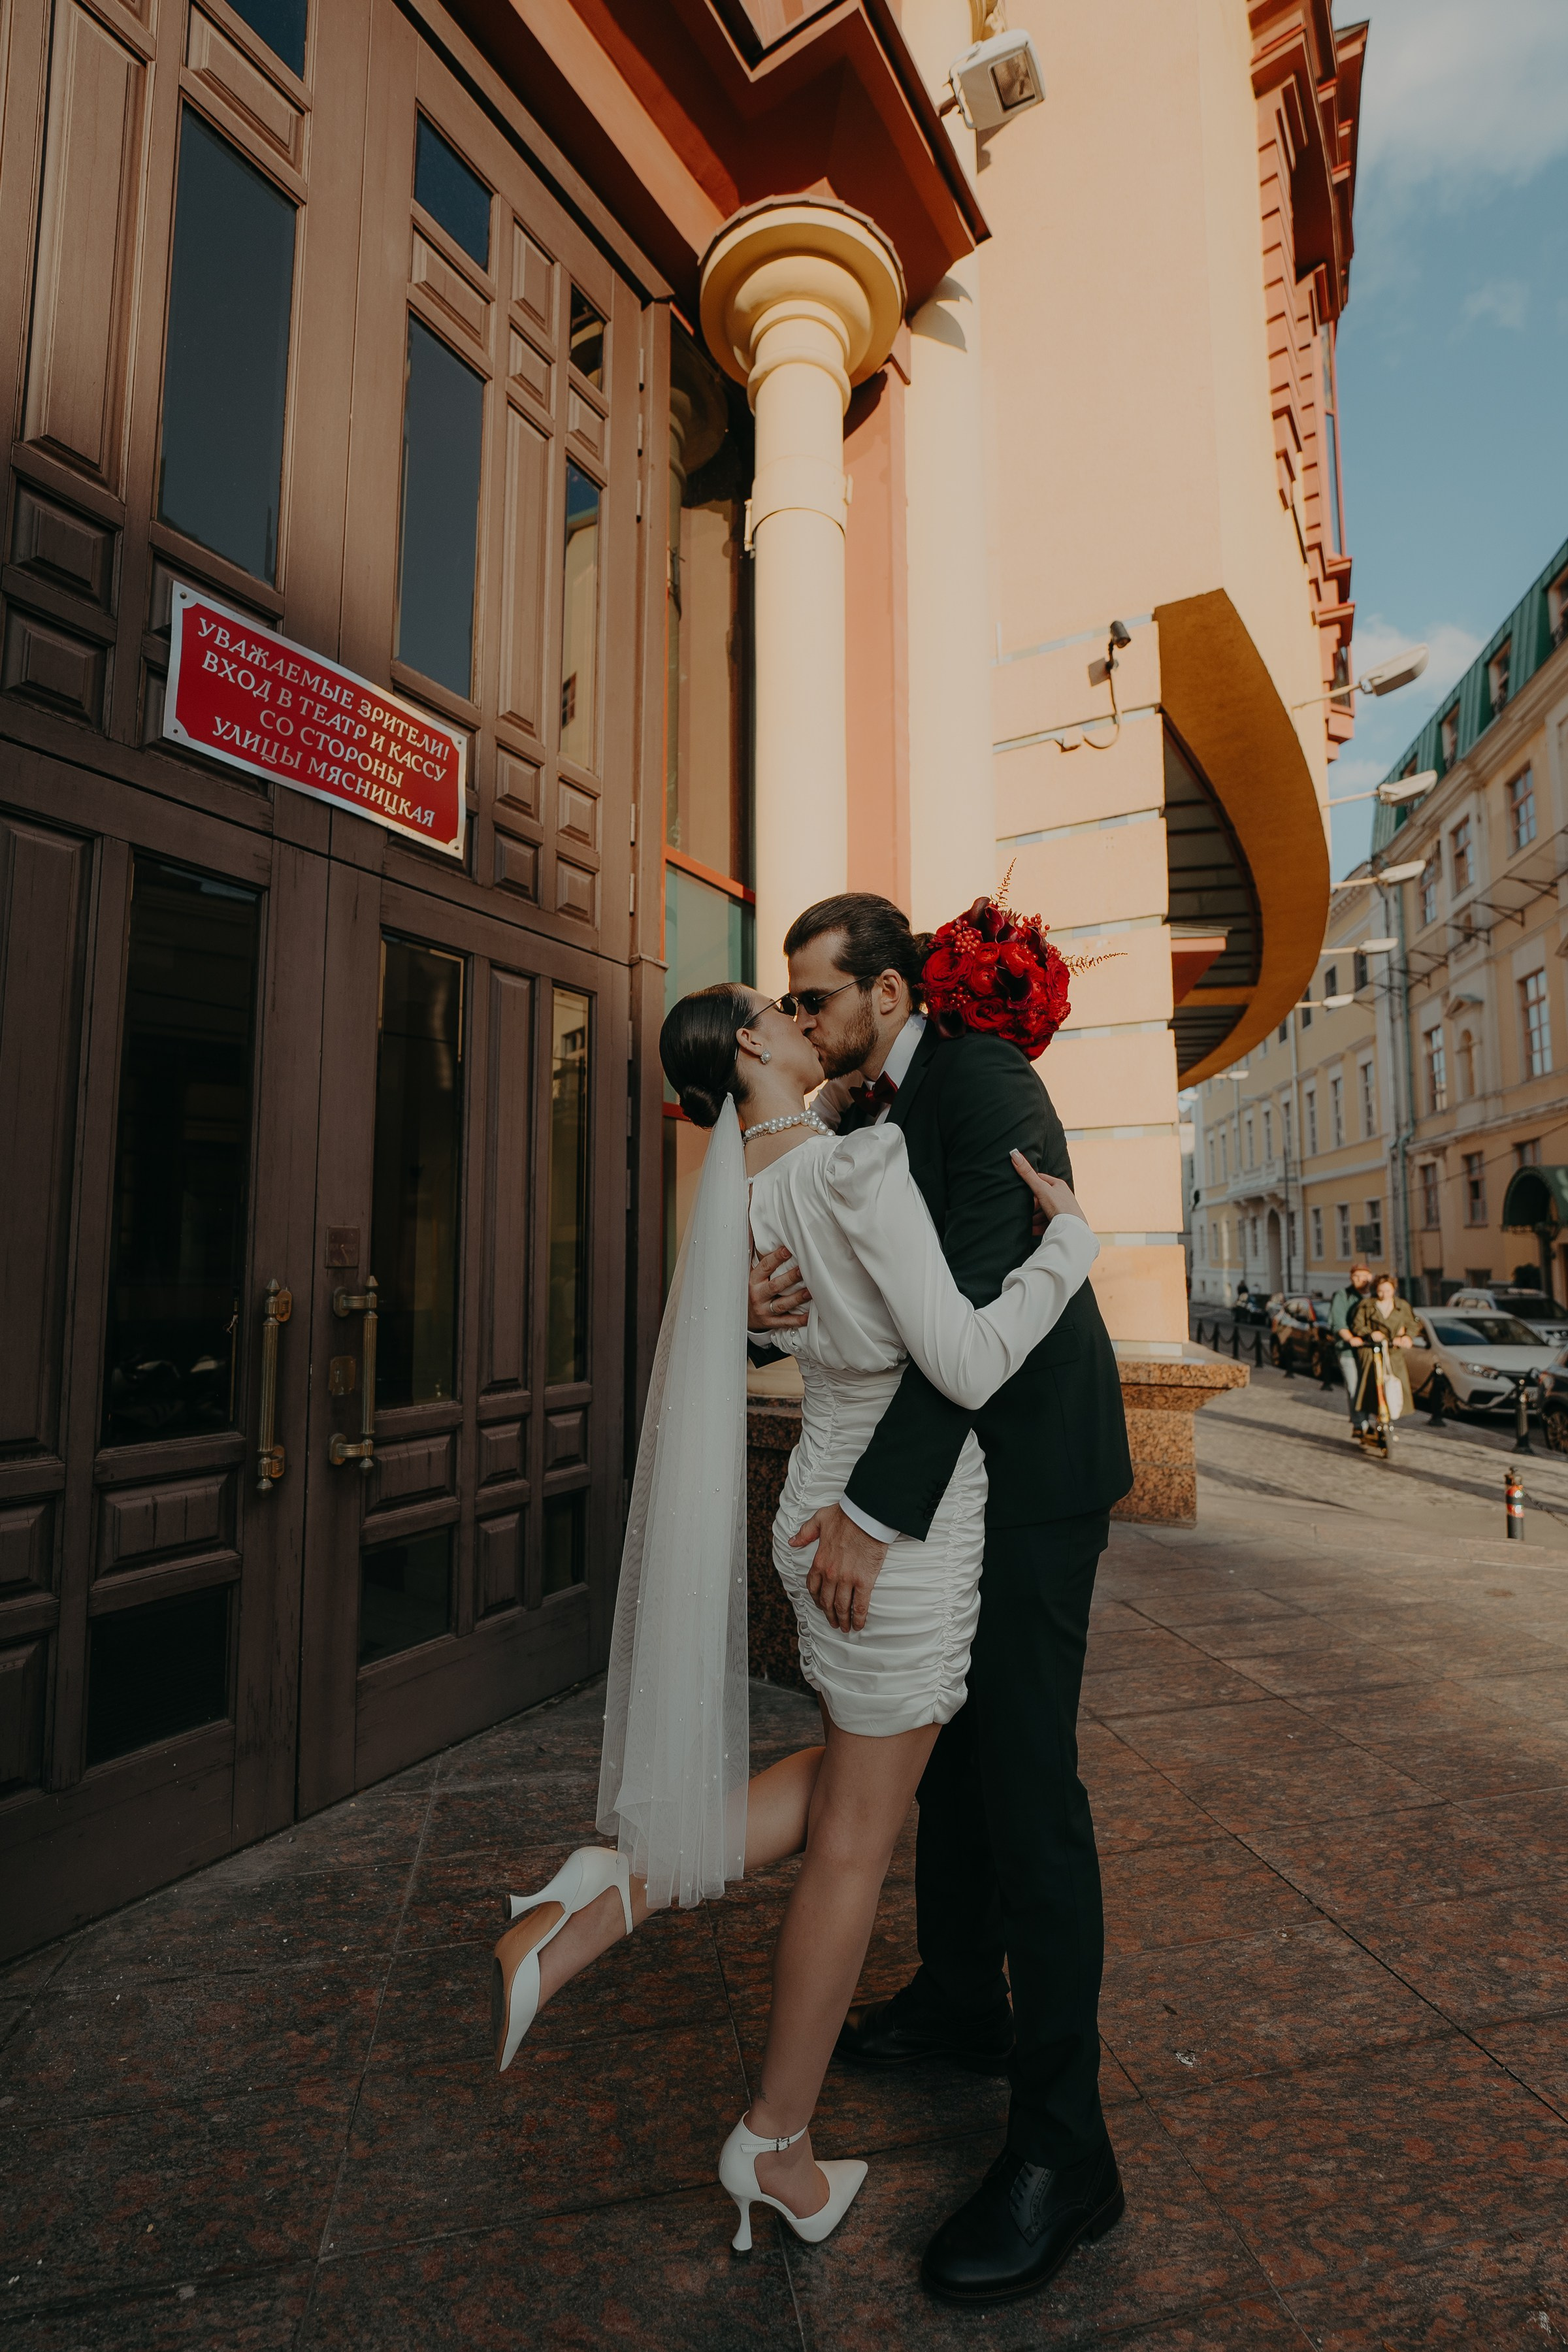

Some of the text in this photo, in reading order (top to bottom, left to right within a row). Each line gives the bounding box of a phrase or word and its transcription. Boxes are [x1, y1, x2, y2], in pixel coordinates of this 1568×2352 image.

[198, 617, 449, 762] УВАЖАЕМЫЕ ЗРИТЕЛИ!
[202, 650, 447, 782] ВХОД В ТЕАТР И КАССУ
[259, 710, 404, 789] СО СТОРОНЫ
[212, 716, 436, 828] УЛИЦЫ МЯСНИЦКАЯ
